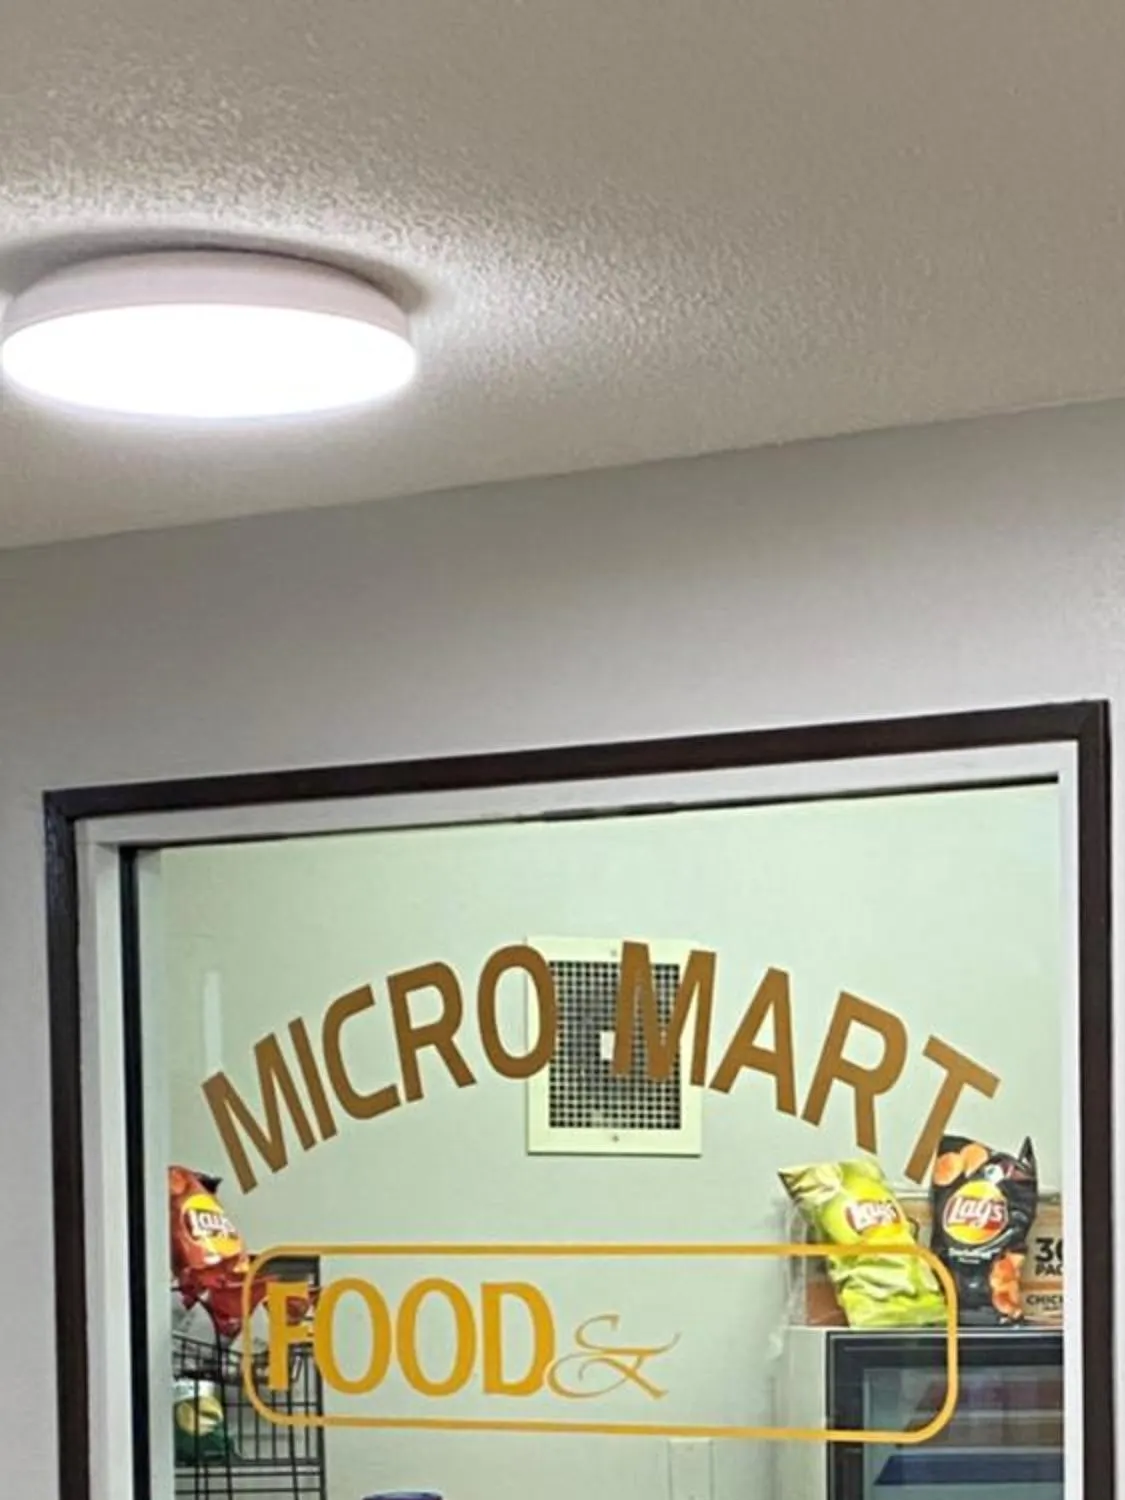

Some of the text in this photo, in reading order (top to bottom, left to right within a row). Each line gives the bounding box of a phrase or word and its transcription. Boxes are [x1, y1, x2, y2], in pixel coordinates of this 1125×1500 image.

[202, 940, 1001, 1195] MICRO MART
[947, 1197, 1005, 1230] Lay's
[264, 1277, 683, 1400] FOOD &
